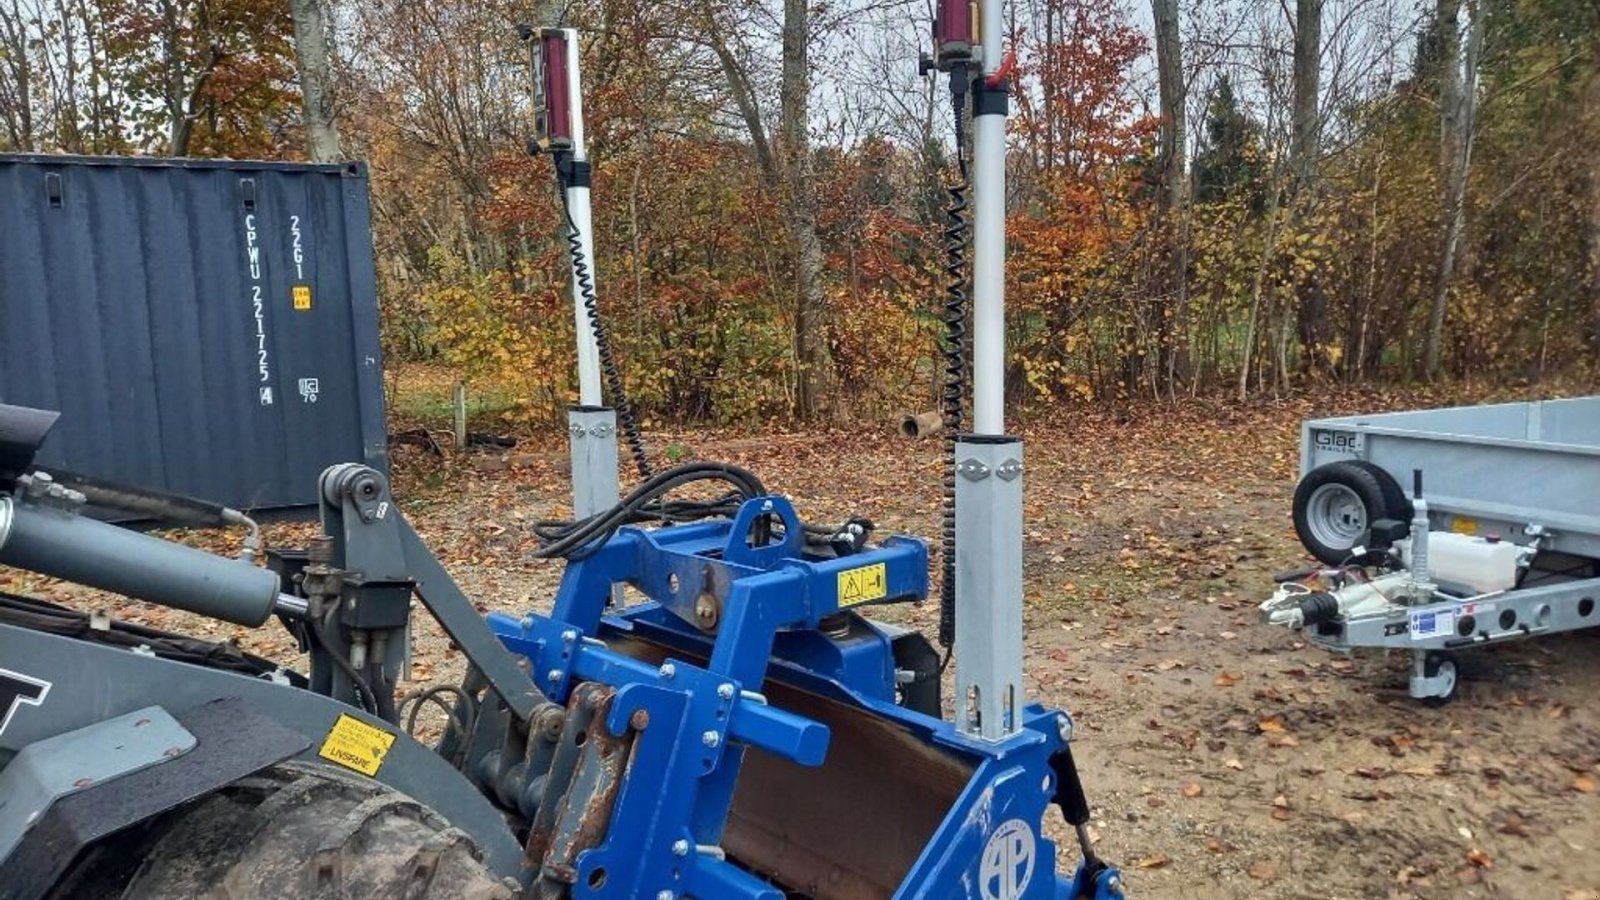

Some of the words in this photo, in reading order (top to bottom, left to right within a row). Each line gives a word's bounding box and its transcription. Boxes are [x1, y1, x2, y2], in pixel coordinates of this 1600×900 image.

[245, 214, 260, 279] CPWU
[291, 215, 303, 279] 22G1
[252, 286, 268, 381] 221725
